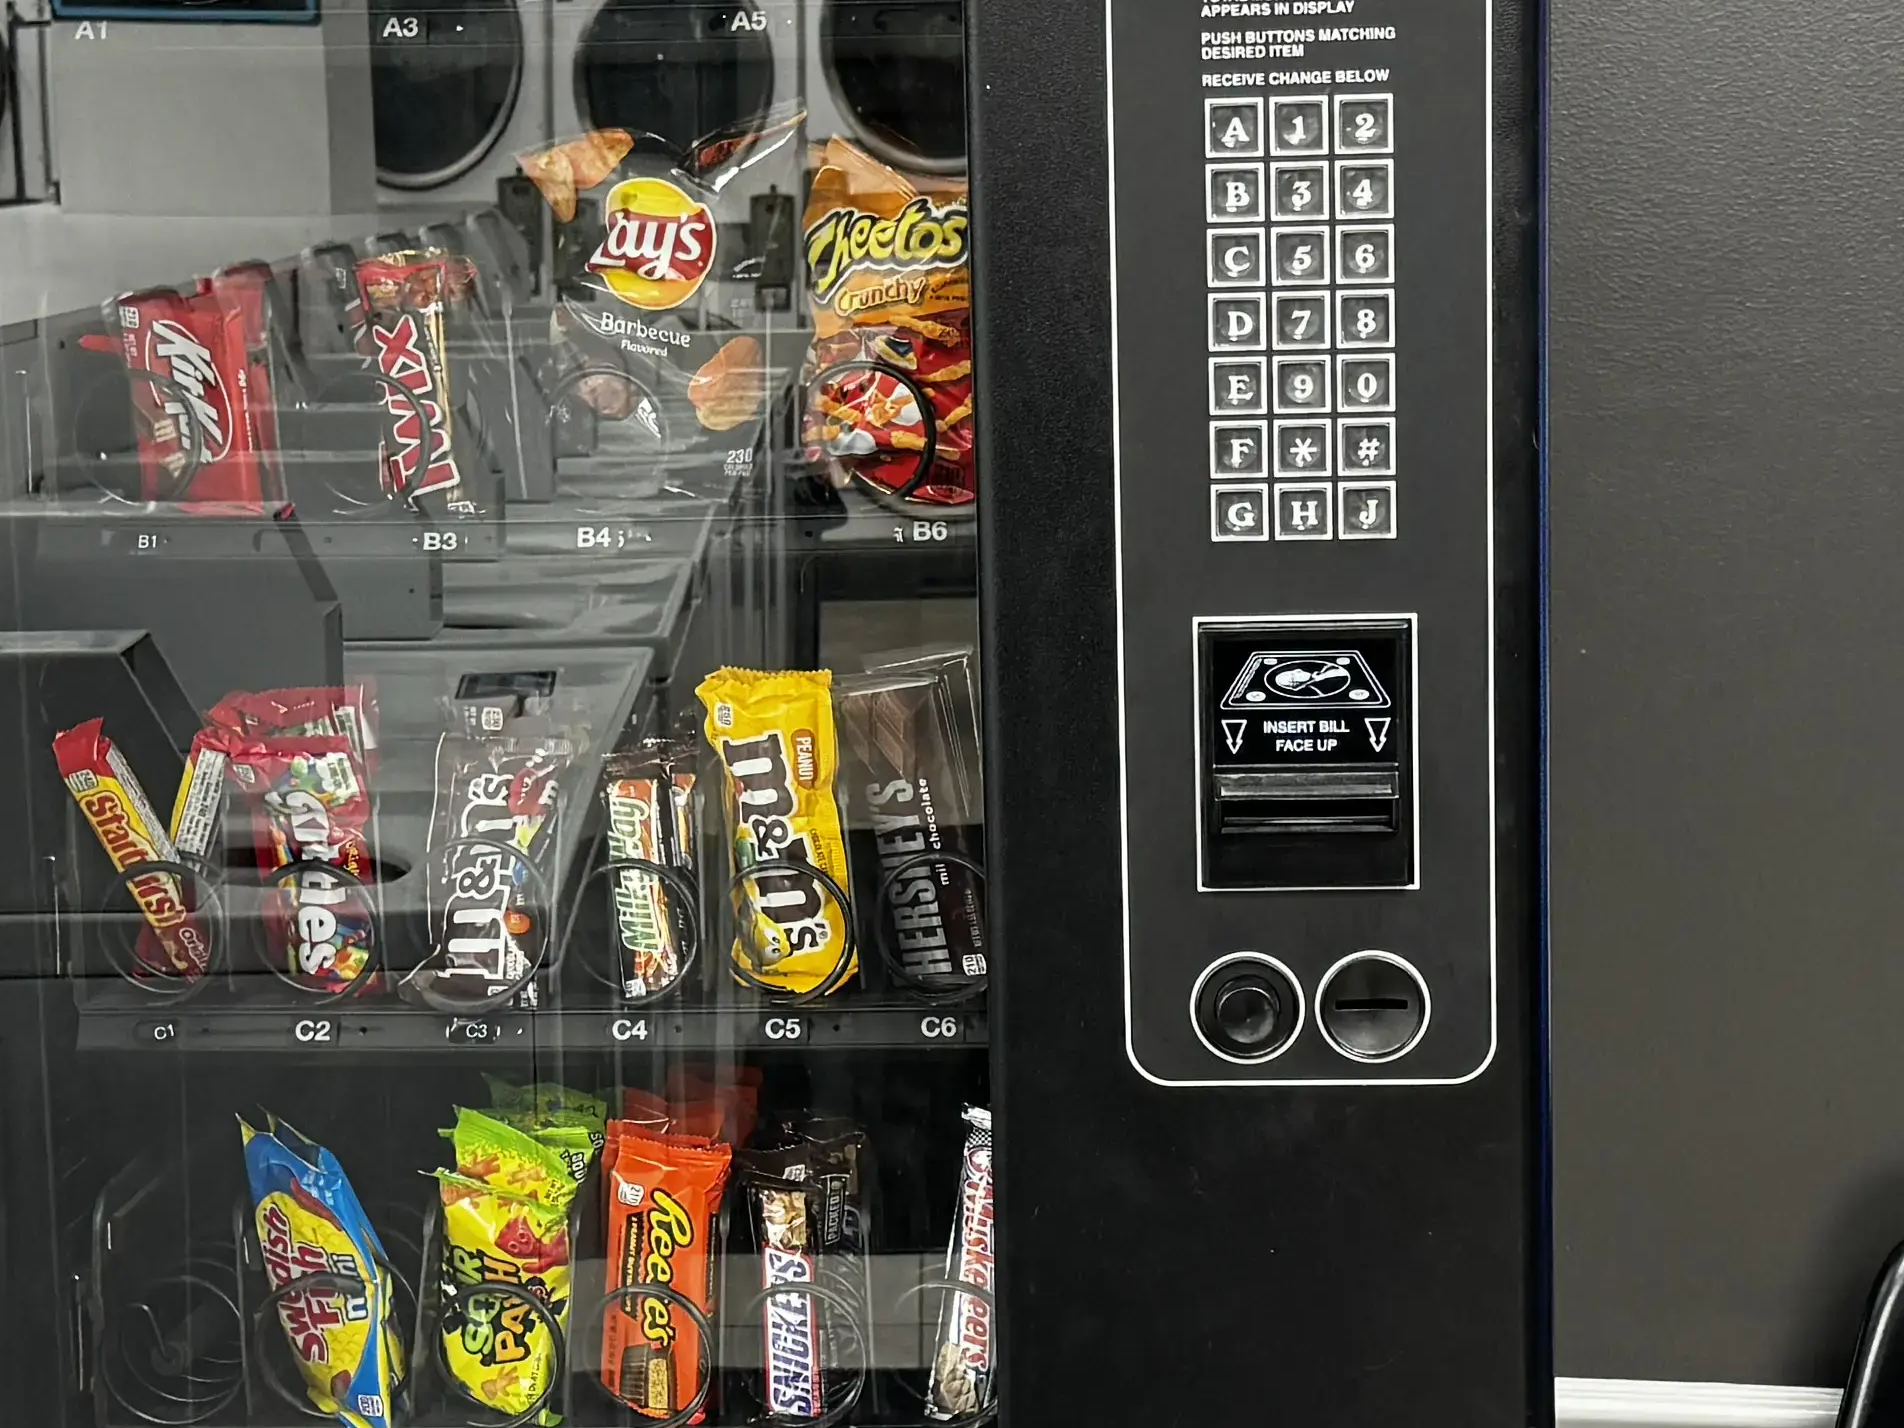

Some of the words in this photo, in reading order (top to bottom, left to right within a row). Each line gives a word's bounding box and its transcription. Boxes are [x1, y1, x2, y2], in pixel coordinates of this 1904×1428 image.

[731, 11, 768, 31] A5
[1201, 2, 1271, 18] APPEARS
[1274, 1, 1290, 16] IN
[1293, 0, 1355, 15] DISPLAY
[75, 21, 108, 40] A1
[382, 16, 419, 37] A3
[1201, 30, 1242, 45] PUSH
[1245, 28, 1315, 44] BUTTONS
[1318, 26, 1396, 42] MATCHING
[1201, 45, 1267, 60] DESIRED
[1269, 43, 1305, 59] ITEM
[1202, 72, 1265, 87] RECEIVE
[1268, 71, 1333, 86] CHANGE
[1335, 68, 1390, 84] BELOW
[1223, 117, 1249, 142] A
[1291, 116, 1307, 140] 1
[1355, 113, 1376, 139] 2
[1225, 182, 1250, 208] B
[1292, 181, 1311, 207] 3
[1352, 179, 1373, 205] 4
[586, 211, 706, 281] Lay's
[1293, 245, 1312, 270] 5
[1356, 244, 1375, 269] 6
[1225, 246, 1250, 272] C
[836, 276, 926, 317] Crunchy
[600, 311, 692, 348] Barbecue
[1228, 311, 1253, 336] D
[1292, 310, 1311, 336] 7
[1357, 309, 1376, 334] 8
[621, 338, 668, 358] Flavored
[1227, 376, 1253, 401] E
[1294, 375, 1314, 400] 9
[1357, 373, 1377, 398] 0
[726, 448, 753, 464] 230
[1230, 439, 1254, 465] F
[1228, 503, 1255, 527] G
[1291, 502, 1318, 526] H
[1358, 500, 1378, 525] J
[138, 534, 158, 551] B1
[423, 532, 458, 551] B3
[577, 527, 611, 547] B4
[913, 521, 948, 541] B6
[1263, 719, 1316, 734] INSERT
[1318, 719, 1351, 734] BILL
[1276, 738, 1313, 752] FACE
[1317, 738, 1339, 752] UP
[795, 736, 815, 782] PEANUT
[919, 778, 941, 849] chocolate
[723, 732, 822, 958] m&m's
[934, 863, 949, 885] mil
[154, 1024, 175, 1040] C1
[296, 1021, 331, 1042] C2
[466, 1024, 488, 1038] C3
[612, 1020, 647, 1040] C4
[765, 1018, 801, 1039] C5
[920, 1018, 956, 1038] C6
[828, 1196, 841, 1240] PACKED
[644, 1189, 694, 1347] Reee's
